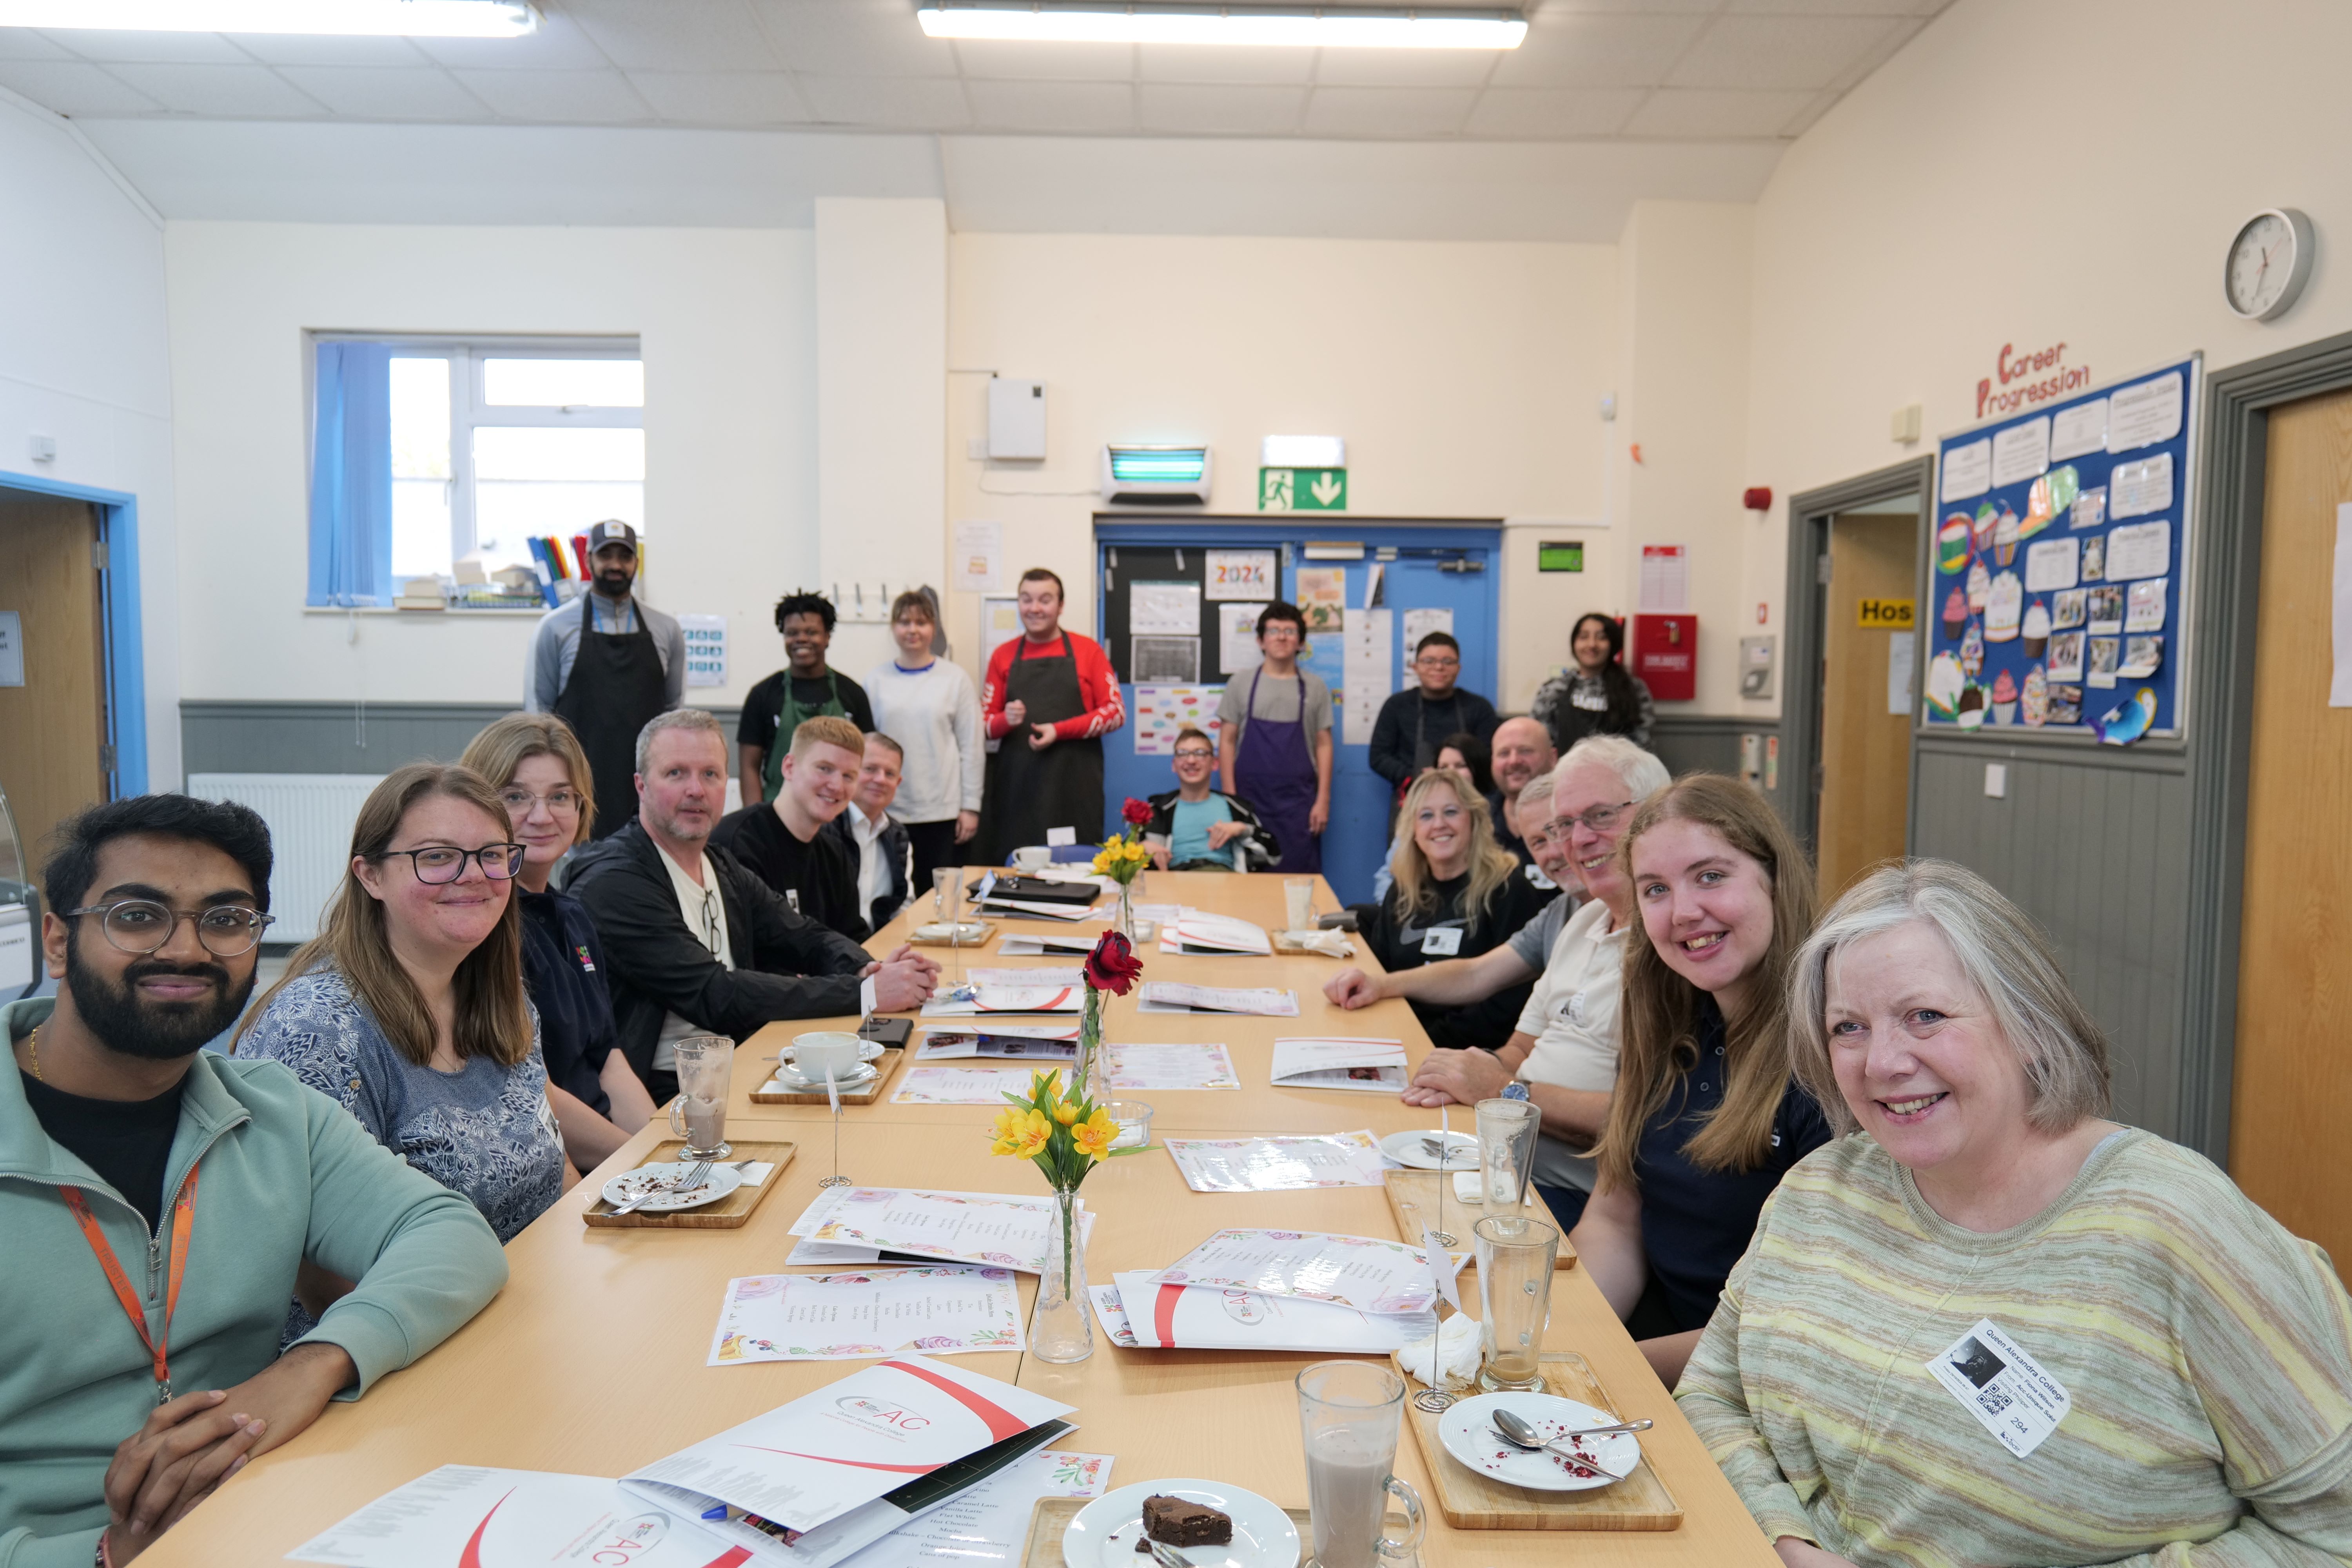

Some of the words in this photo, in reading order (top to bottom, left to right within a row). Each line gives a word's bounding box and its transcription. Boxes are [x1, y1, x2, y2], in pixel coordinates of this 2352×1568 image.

[1998, 342, 2067, 385] Career
[1977, 365, 2089, 418] Progression
[1217, 565, 1264, 583] 2024
[1862, 602, 1911, 621] Hos
[1943, 1365, 1951, 1374] Friday
[1986, 1329, 2006, 1348] Queen
[2005, 1347, 2038, 1377] Alexandra
[2039, 1376, 2064, 1402] College
[1997, 1377, 2013, 1394] Visiting
[2012, 1392, 2030, 1409] Philiper
[2003, 1371, 2016, 1384] From:
[2016, 1384, 2043, 1410] Acc-Unique
[2043, 1410, 2056, 1423] Solut
[2010, 1365, 2025, 1380] Name:
[2024, 1379, 2038, 1394] Fiona
[2038, 1392, 2054, 1409] Wilson
[837, 1411, 855, 1419] Queen
[856, 1417, 883, 1429] Alexandra
[883, 1427, 905, 1436] College
[2010, 1417, 2028, 1434] 294
